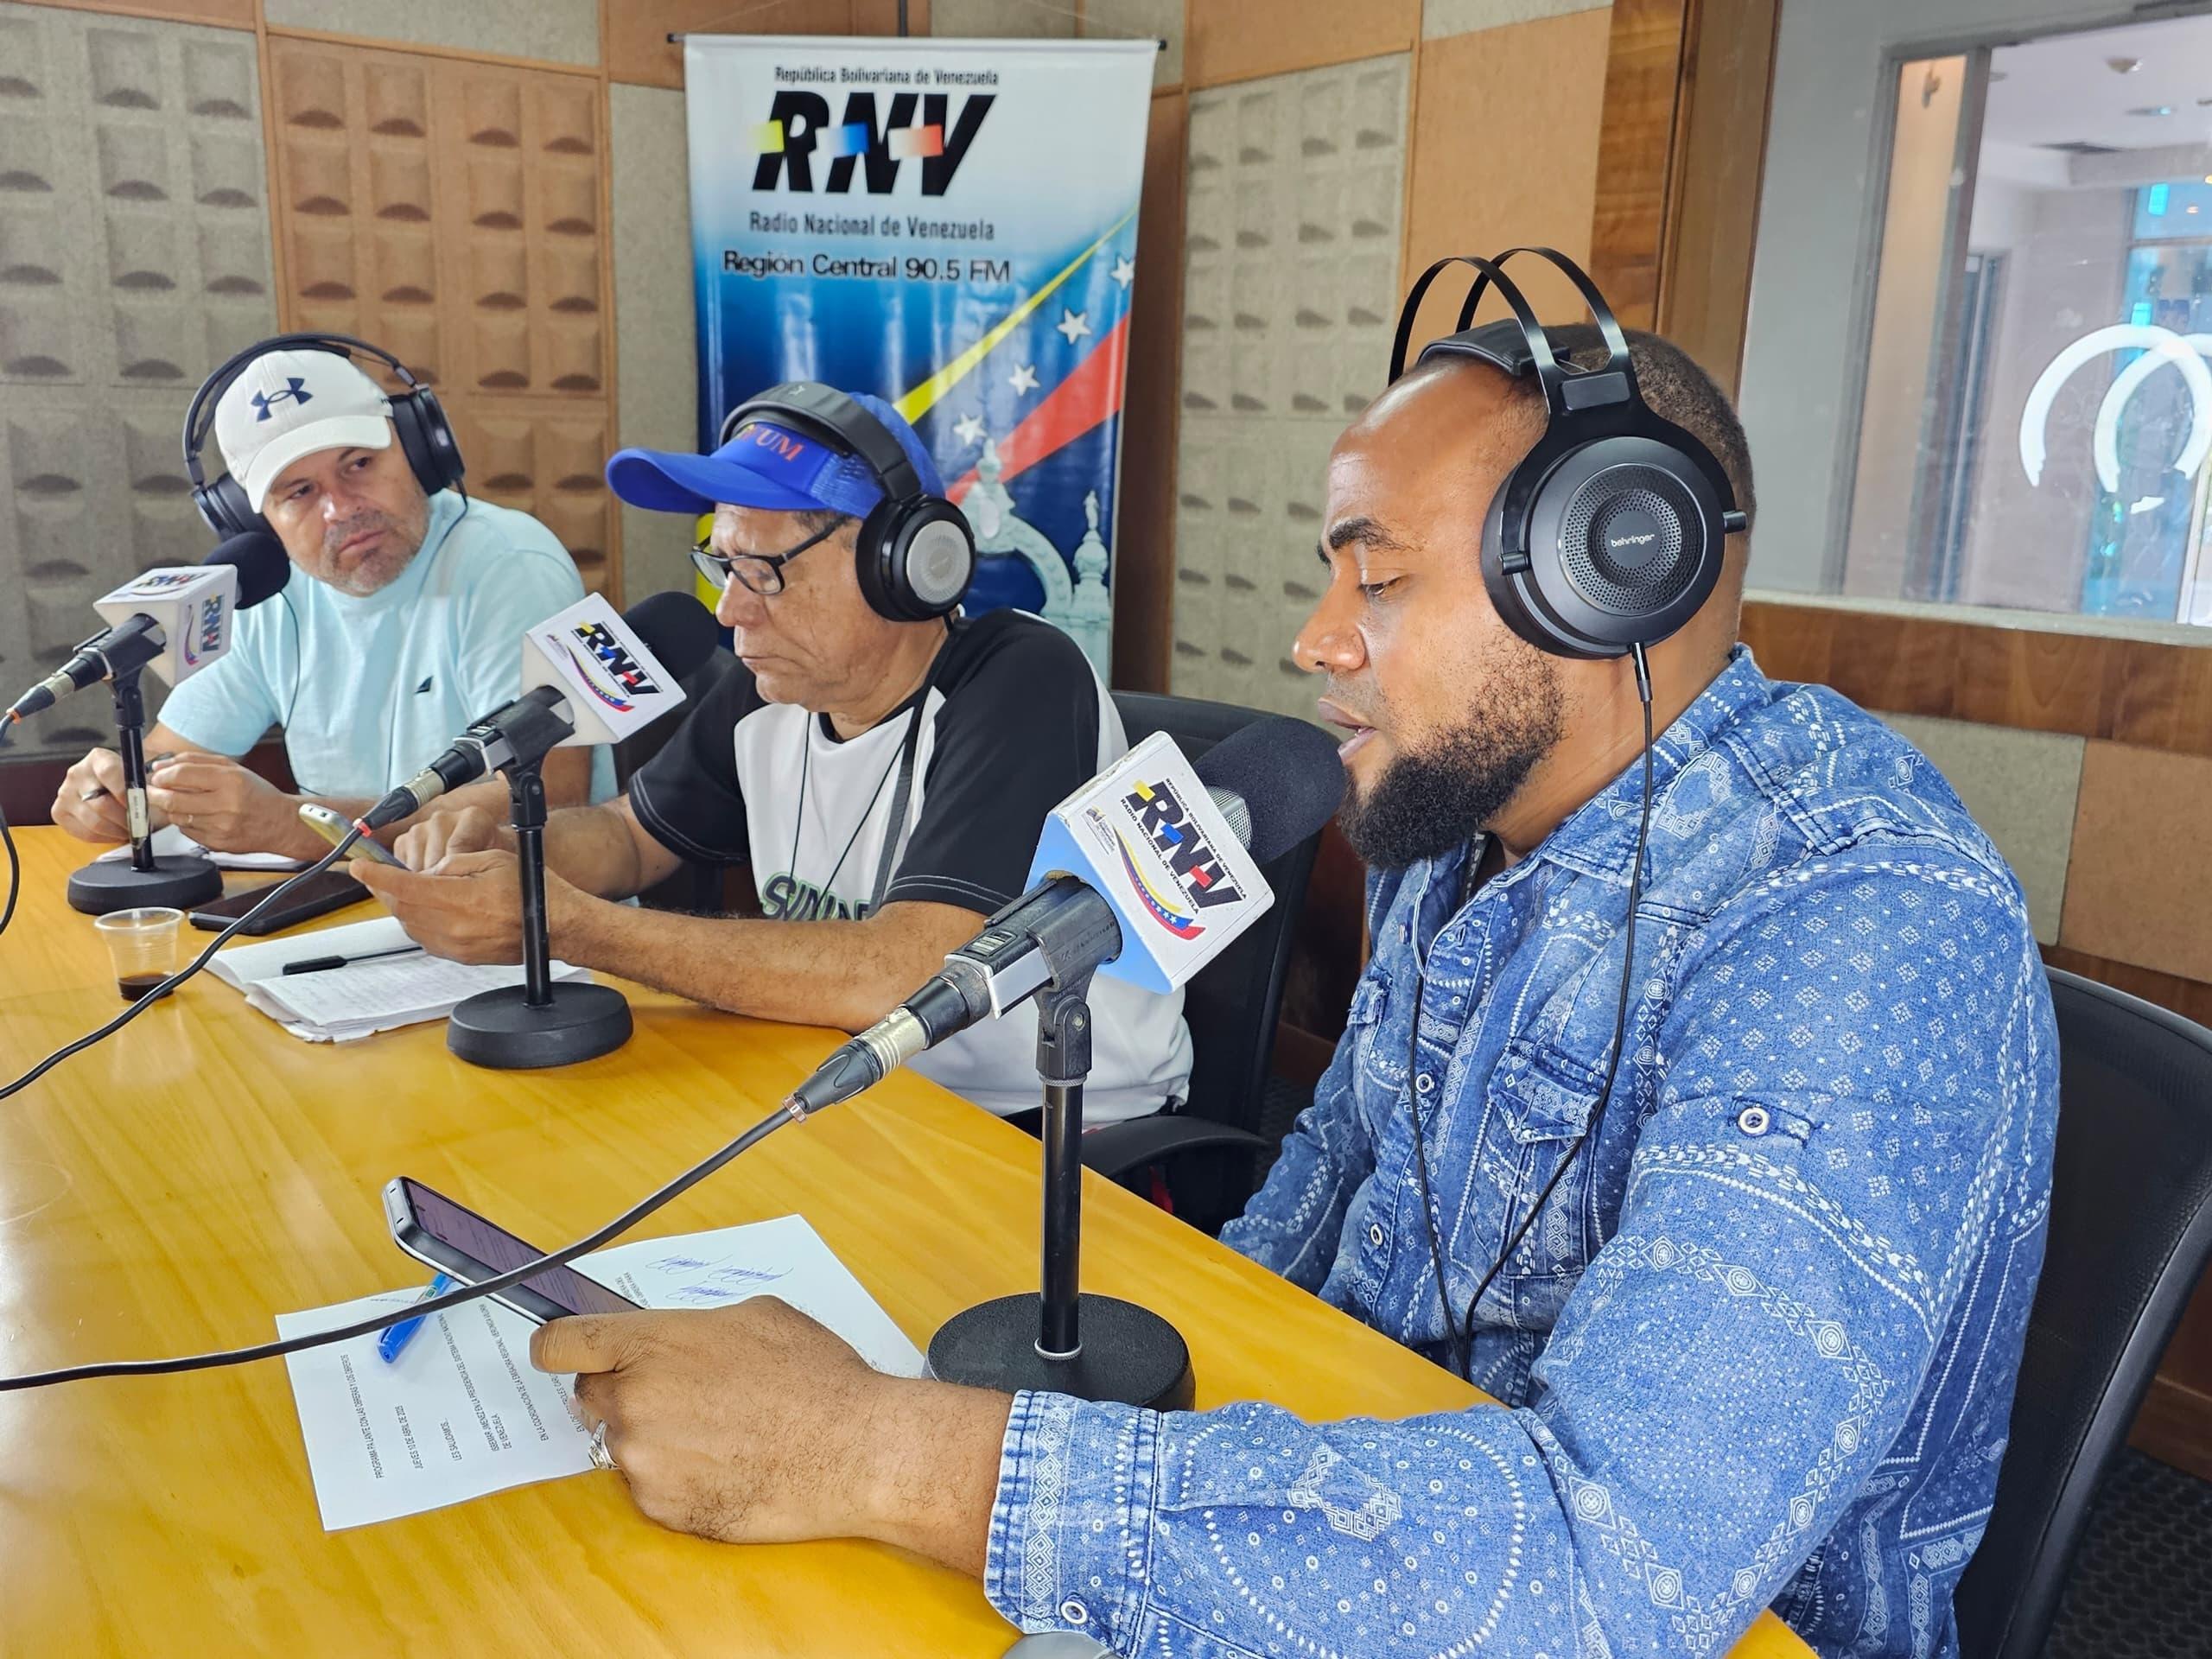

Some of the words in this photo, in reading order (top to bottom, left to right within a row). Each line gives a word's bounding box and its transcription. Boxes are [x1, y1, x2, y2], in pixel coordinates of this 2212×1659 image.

[841, 67, 910, 83] Bolivariana
[916, 69, 929, 84] de
[935, 69, 999, 85] Venezuela
[751, 90, 996, 196] RNV
[749, 212, 798, 234] Radio
[804, 213, 874, 236] Nacional
[880, 218, 900, 237] de
[906, 219, 995, 240] Venezuela
[812, 253, 897, 277] Central
[906, 257, 960, 281] 90.5
[969, 260, 1009, 282] FM
[1611, 534, 1655, 547] behringer
[203, 594, 223, 652] RNV
[573, 622, 661, 696] RNV
[1120, 798, 1137, 822] RADIO
[1135, 822, 1163, 860] NACIONAL
[1161, 860, 1170, 871] DE
[1168, 871, 1199, 914] VENEZUELA
[1125, 779, 1243, 909] RNV
[1221, 862, 1247, 899] VENEZUELA
[404, 1436, 415, 1445] DE
[368, 1449, 384, 1478] PROGRAMA
[409, 1450, 423, 1470] JUEVES
